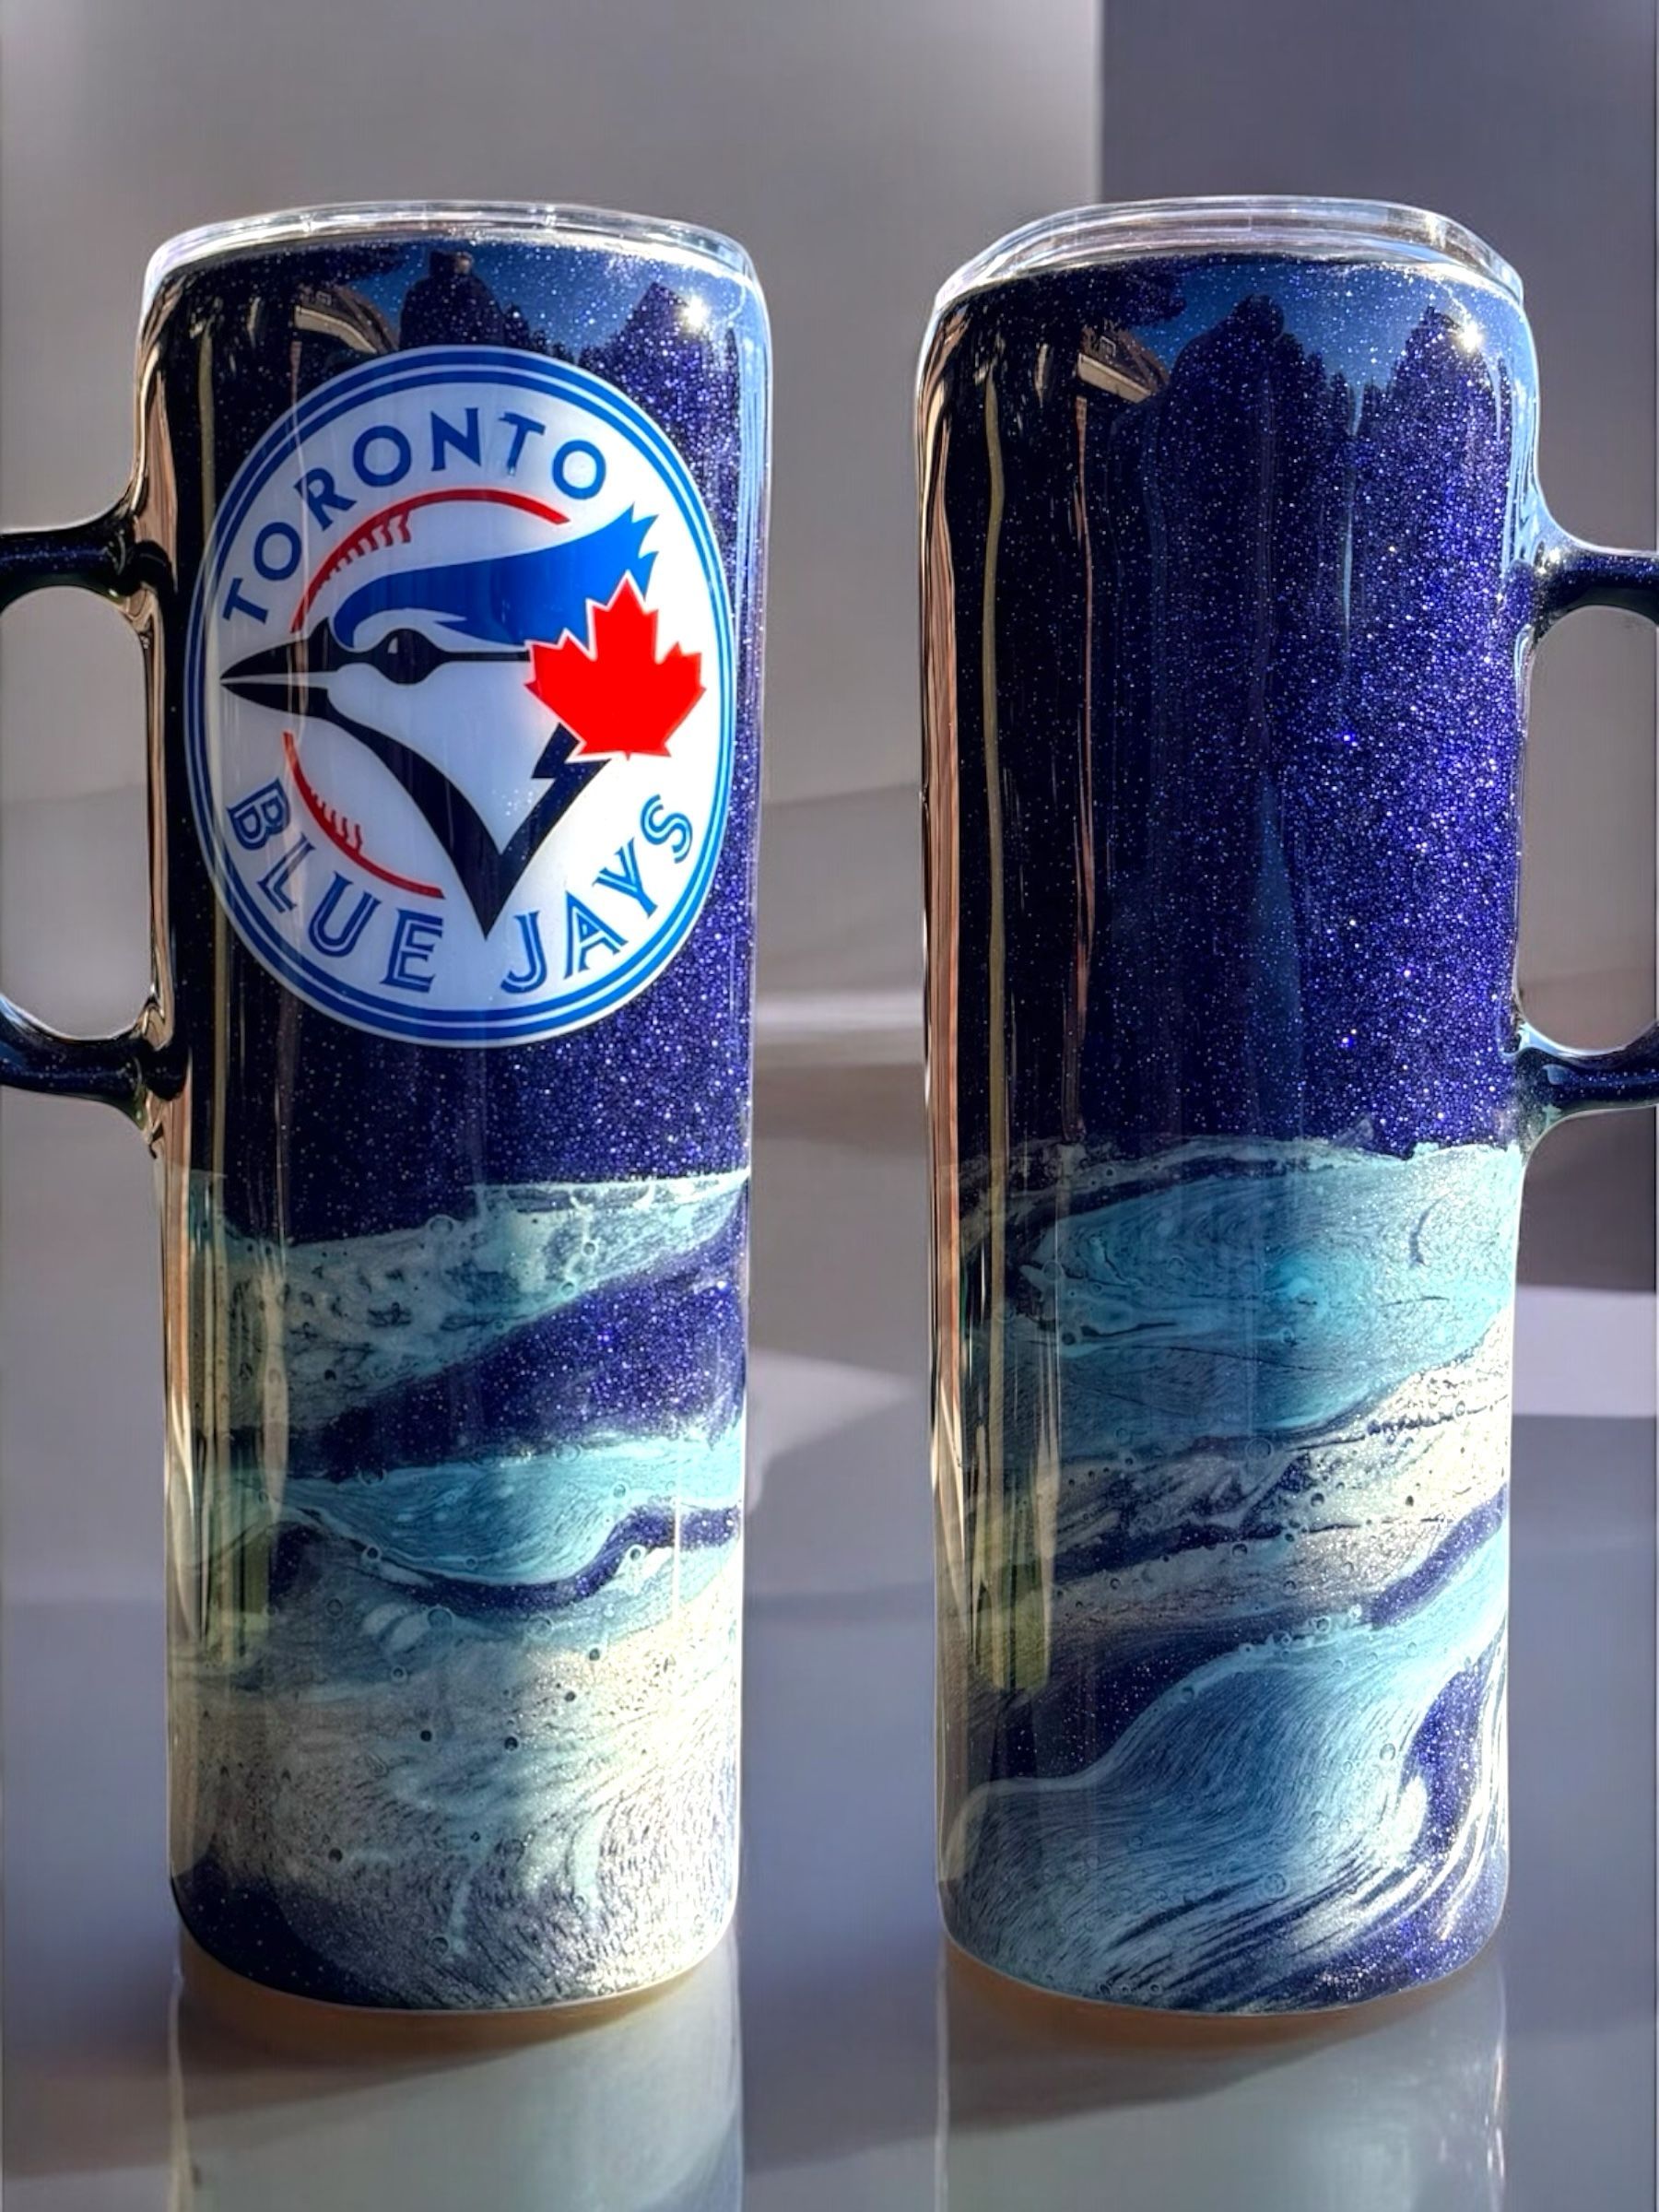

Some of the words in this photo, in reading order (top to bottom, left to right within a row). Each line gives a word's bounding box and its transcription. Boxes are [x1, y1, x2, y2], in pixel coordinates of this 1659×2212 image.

[223, 407, 606, 625] TORONTO
[226, 779, 444, 993] BLUE
[500, 794, 693, 994] JAYS
